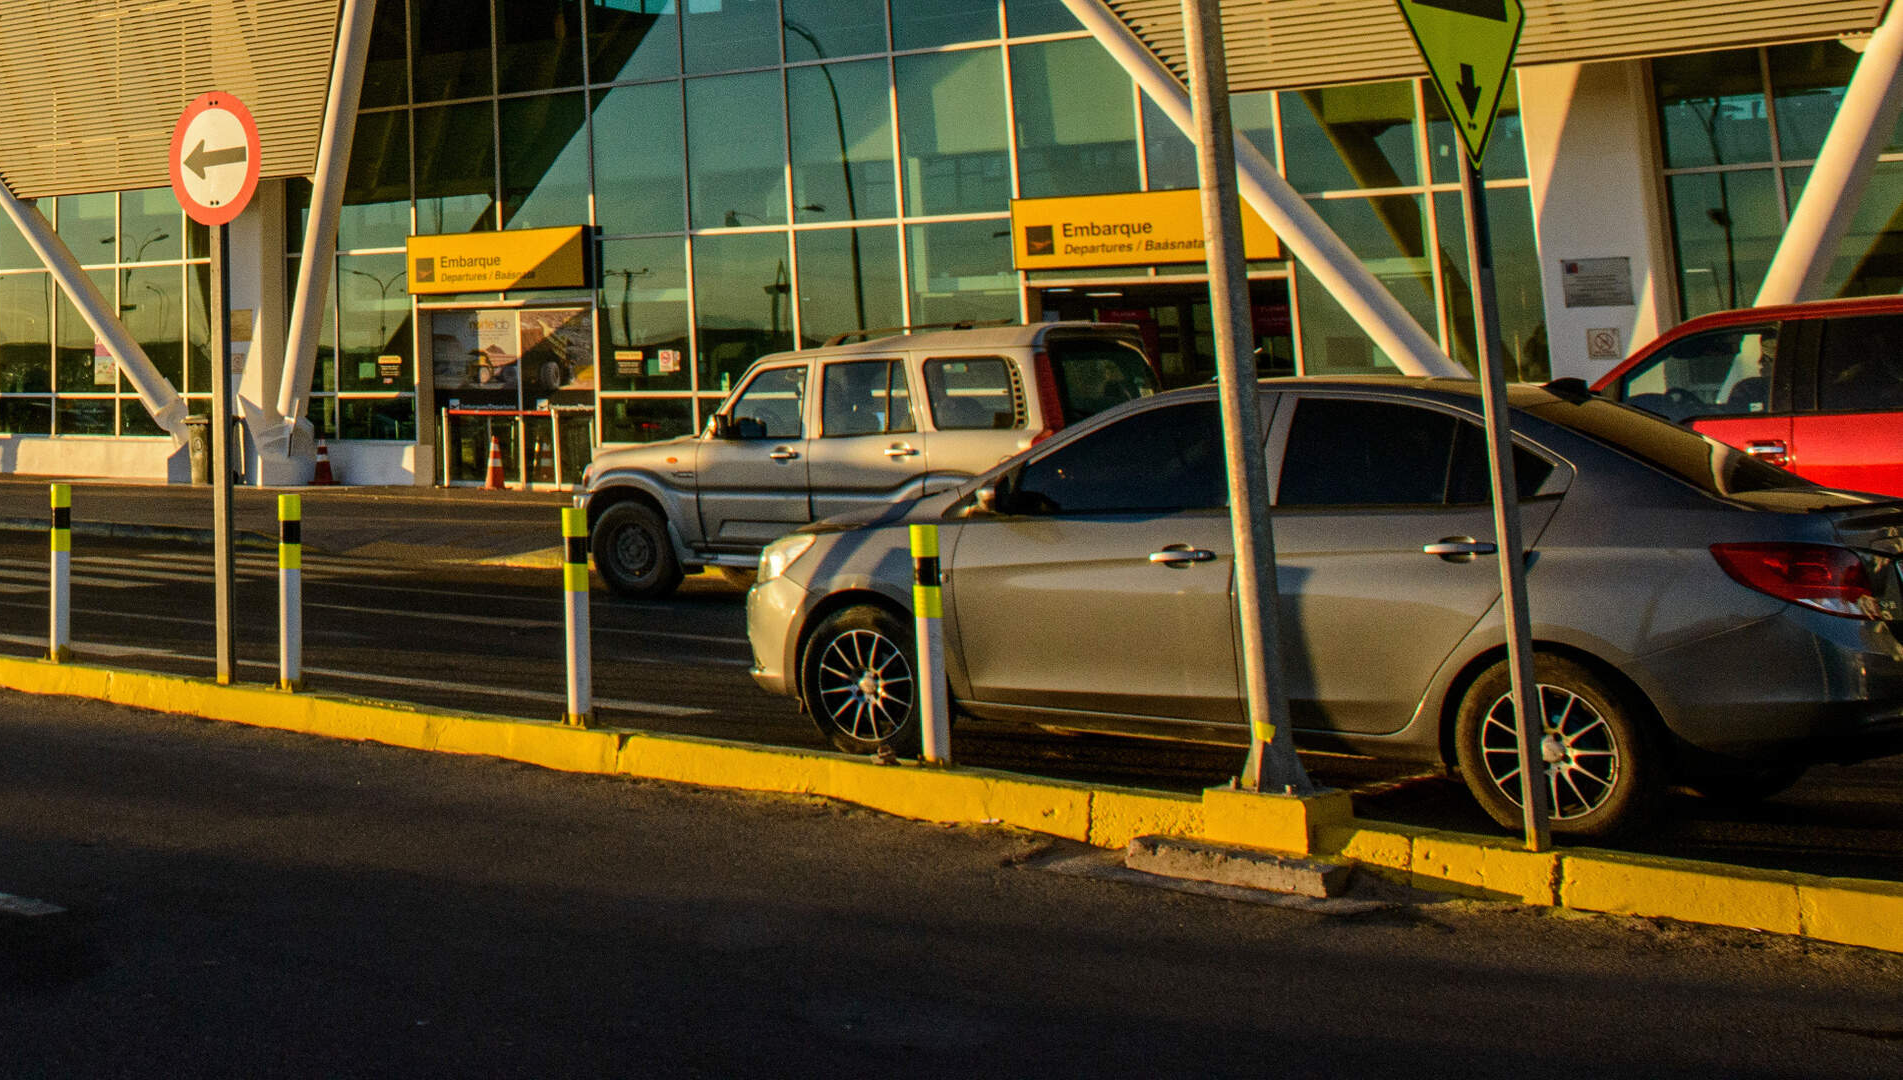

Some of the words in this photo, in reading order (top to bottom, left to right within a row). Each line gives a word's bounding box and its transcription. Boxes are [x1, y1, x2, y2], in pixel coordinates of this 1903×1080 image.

[1062, 222, 1153, 238] Embarque
[1064, 242, 1133, 256] Departures
[440, 256, 501, 269] Embarque
[441, 271, 487, 284] Departures
